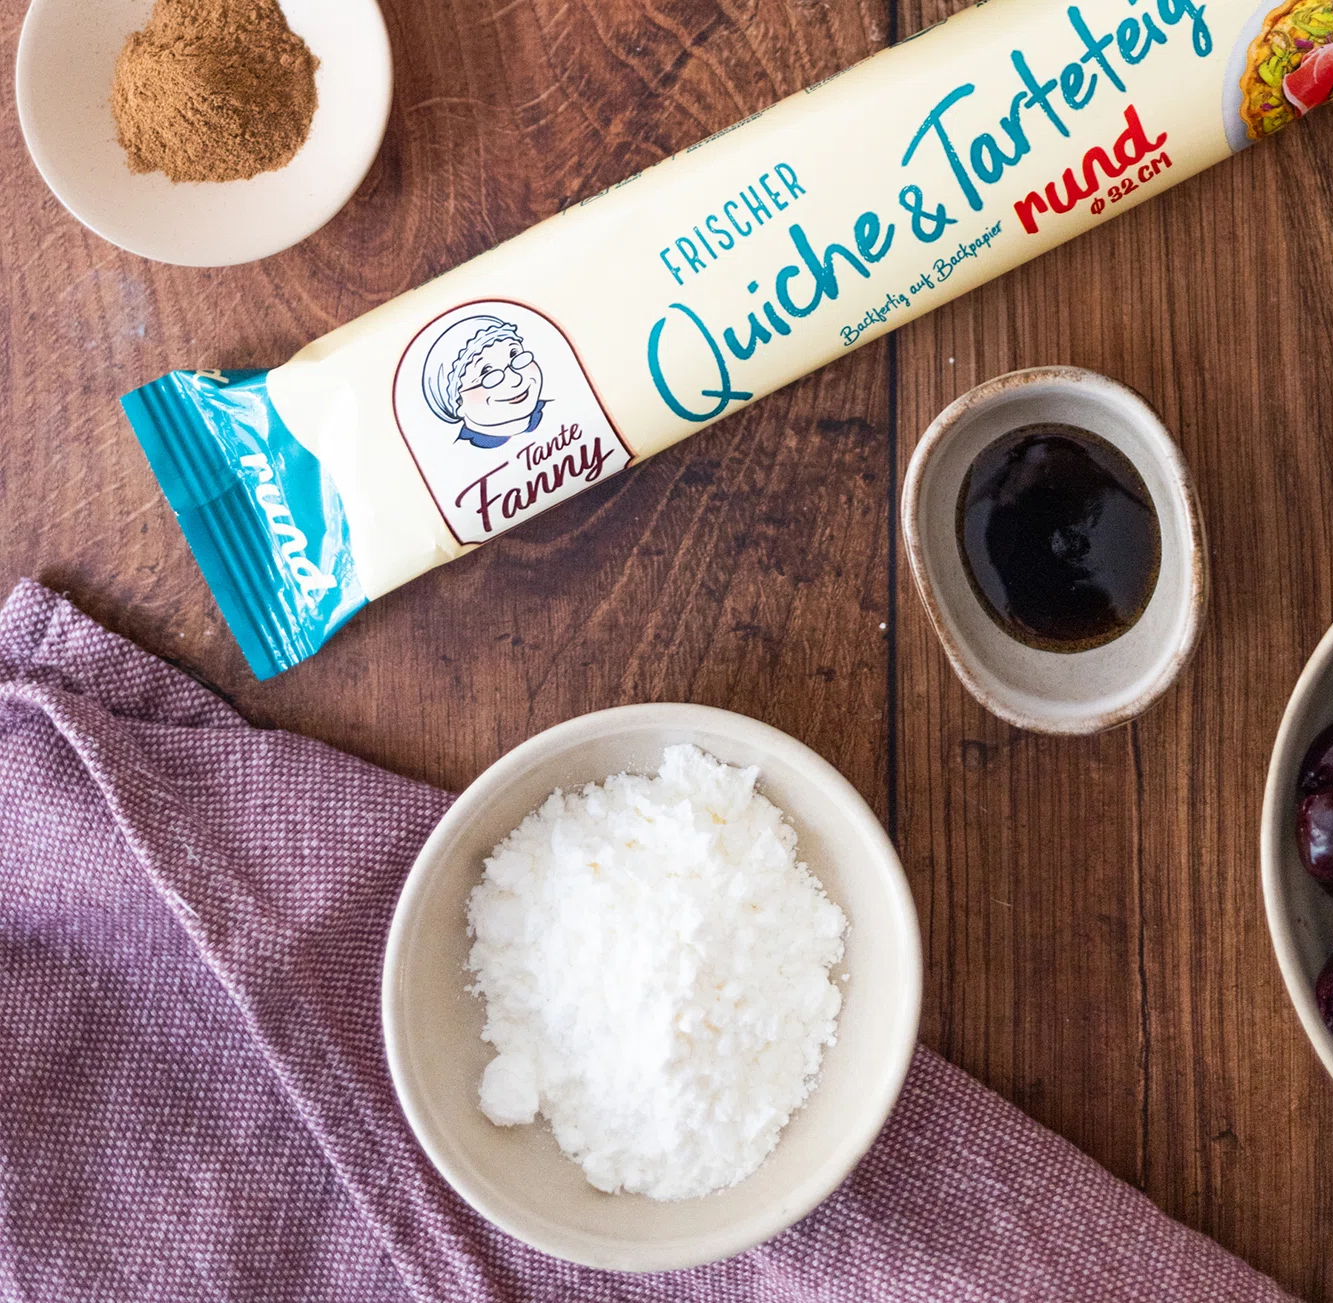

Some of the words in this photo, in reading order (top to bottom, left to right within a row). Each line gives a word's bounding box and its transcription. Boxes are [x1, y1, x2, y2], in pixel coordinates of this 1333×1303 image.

[660, 162, 807, 286] FRISCHER
[1013, 103, 1168, 235] rund
[1107, 178, 1139, 203] 32
[1137, 151, 1173, 184] CM
[647, 210, 895, 423] Quiche
[899, 185, 958, 243] &
[840, 293, 911, 347] Backfertig
[909, 273, 935, 295] auf
[932, 219, 1002, 283] Backpapier
[455, 437, 615, 533] Fanny
[516, 423, 583, 471] Tante
[240, 453, 338, 610] rund
